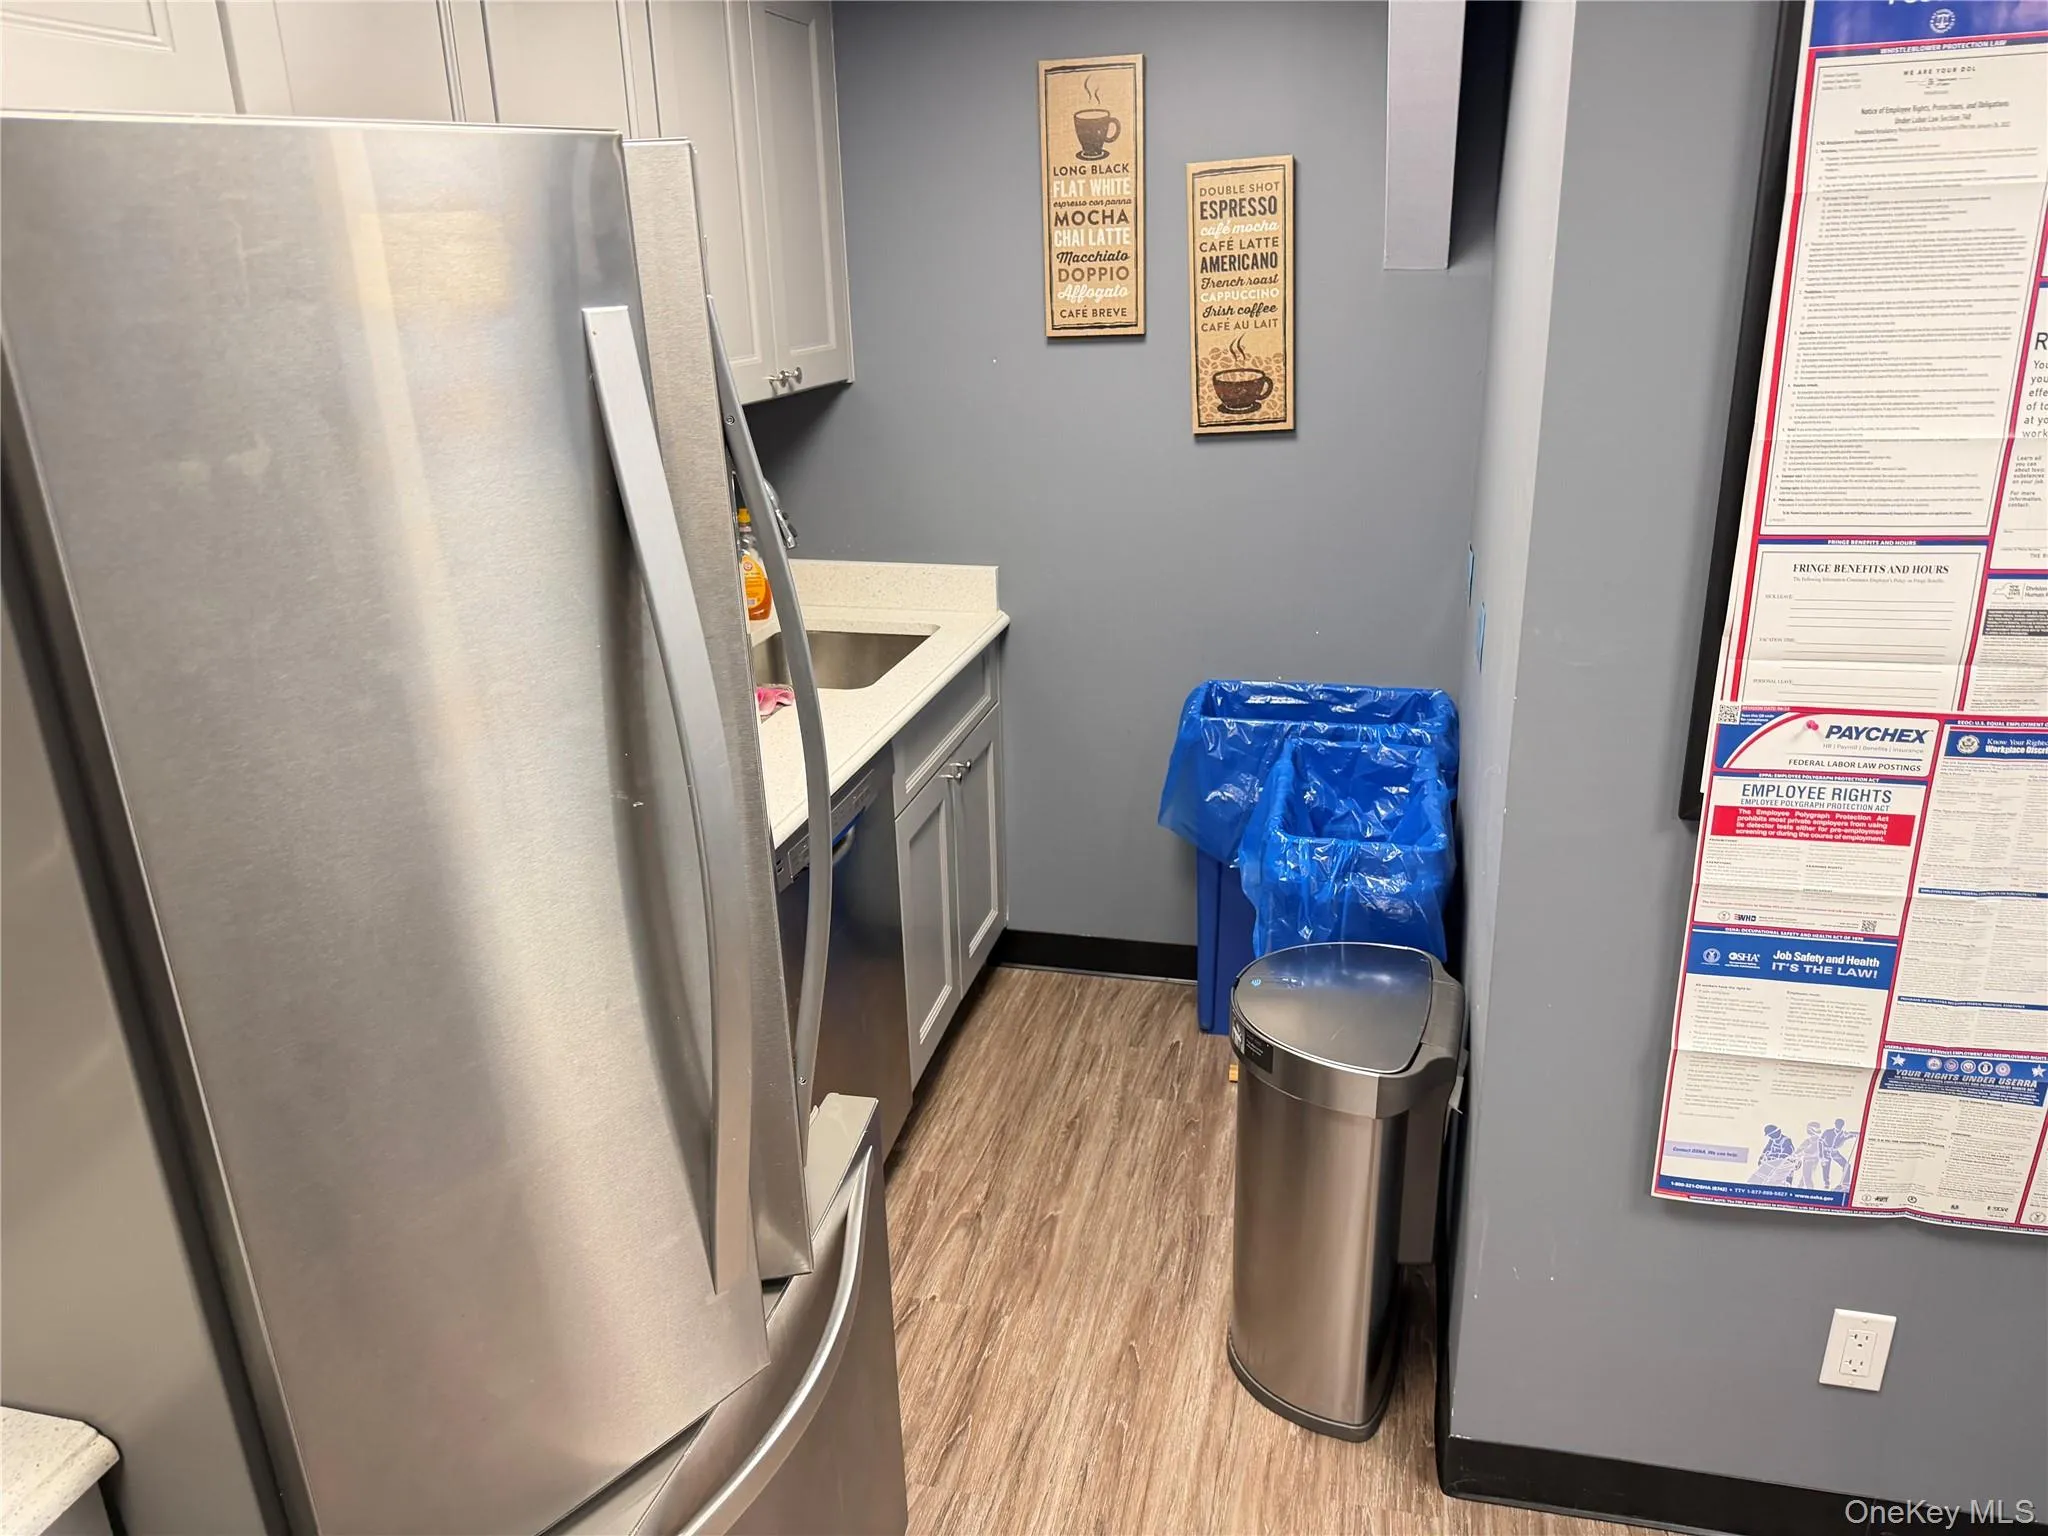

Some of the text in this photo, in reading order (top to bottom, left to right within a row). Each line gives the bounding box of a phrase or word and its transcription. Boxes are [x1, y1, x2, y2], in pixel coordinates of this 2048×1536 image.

[1880, 39, 2007, 54] WHISTLEBLOWER PROTECTION LAW
[1053, 163, 1129, 176] LONG BLACK
[1053, 177, 1131, 198] FLAT WHITE
[1200, 181, 1280, 197] DOUBLE SHOT
[1053, 200, 1087, 208] espresso
[1104, 198, 1132, 207] panna
[1200, 195, 1278, 220] ESPRESSO
[1054, 209, 1130, 227] MOCHA
[1054, 227, 1132, 247] CHAI LATTE
[1200, 220, 1280, 239] café mocha
[1199, 236, 1279, 252] CAFÉ LATTE
[1056, 250, 1131, 266] Macchiato
[1200, 251, 1278, 274] AMERICANO
[1058, 266, 1130, 282] DOPPIO
[1201, 273, 1280, 290] French roast
[1057, 284, 1130, 304] Affogato
[1200, 287, 1280, 302] CAPPUCCINO
[1060, 305, 1127, 319] CAFÉ BREVE
[1202, 302, 1278, 318] Irish coffee
[1201, 317, 1279, 332] CAFÉ AU LAIT
[1793, 563, 1950, 574] FRINGE BENEFITS AND HOURS
[1825, 725, 1929, 744] PAYCHEX
[1985, 745, 2026, 754] Workplace
[1788, 758, 1921, 771] FEDERAL LABOR LAW POSTINGS
[1742, 784, 1892, 803] EMPLOYEE RIGHTS
[1780, 800, 1825, 809] POLYGRAPH
[1826, 802, 1873, 811] PROTECTION
[1737, 815, 1767, 823] prohibits
[1787, 817, 1811, 825] private
[1756, 809, 1790, 817] Employee
[1795, 811, 1830, 819] Polygraph
[1835, 813, 1872, 821] Protection
[1776, 830, 1798, 838] during
[1830, 827, 1887, 836] pre-employment
[1728, 952, 1758, 962] OSHA
[1772, 950, 1880, 967] Job Safety and Health
[1771, 962, 1799, 972] IT'S
[1803, 964, 1833, 975] THE
[1837, 967, 1878, 979] LAW!
[1896, 1069, 1921, 1077] YOUR
[1924, 1072, 1959, 1080] RIGHTS
[1962, 1075, 1996, 1085] UNDER
[1998, 1078, 2038, 1088] USERRA
